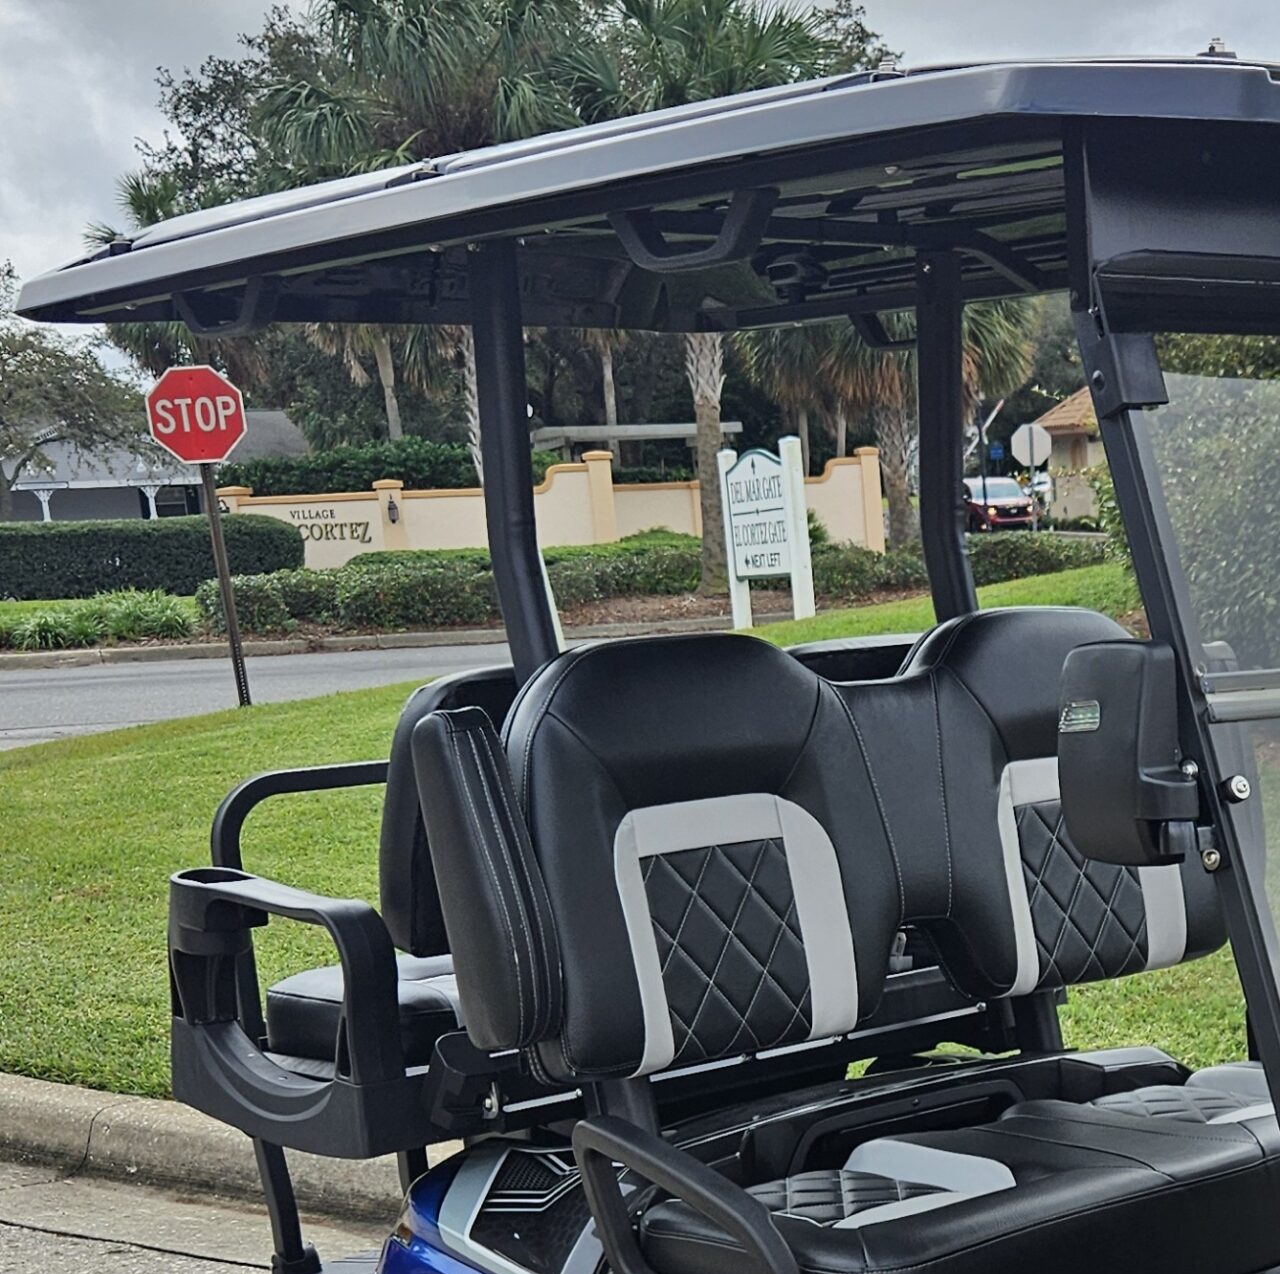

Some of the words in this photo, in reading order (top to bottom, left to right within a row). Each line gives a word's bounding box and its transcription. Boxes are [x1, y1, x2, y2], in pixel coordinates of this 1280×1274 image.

[155, 395, 236, 434] STOP
[730, 481, 745, 504] DEL
[745, 478, 763, 502] MAR
[763, 475, 782, 500] GATE
[289, 509, 336, 520] VILLAGE
[298, 521, 372, 544] CORTEZ
[743, 522, 768, 546] CORTEZ
[768, 520, 787, 544] GATE
[751, 553, 766, 568] NEXT
[766, 552, 781, 567] LEFT
